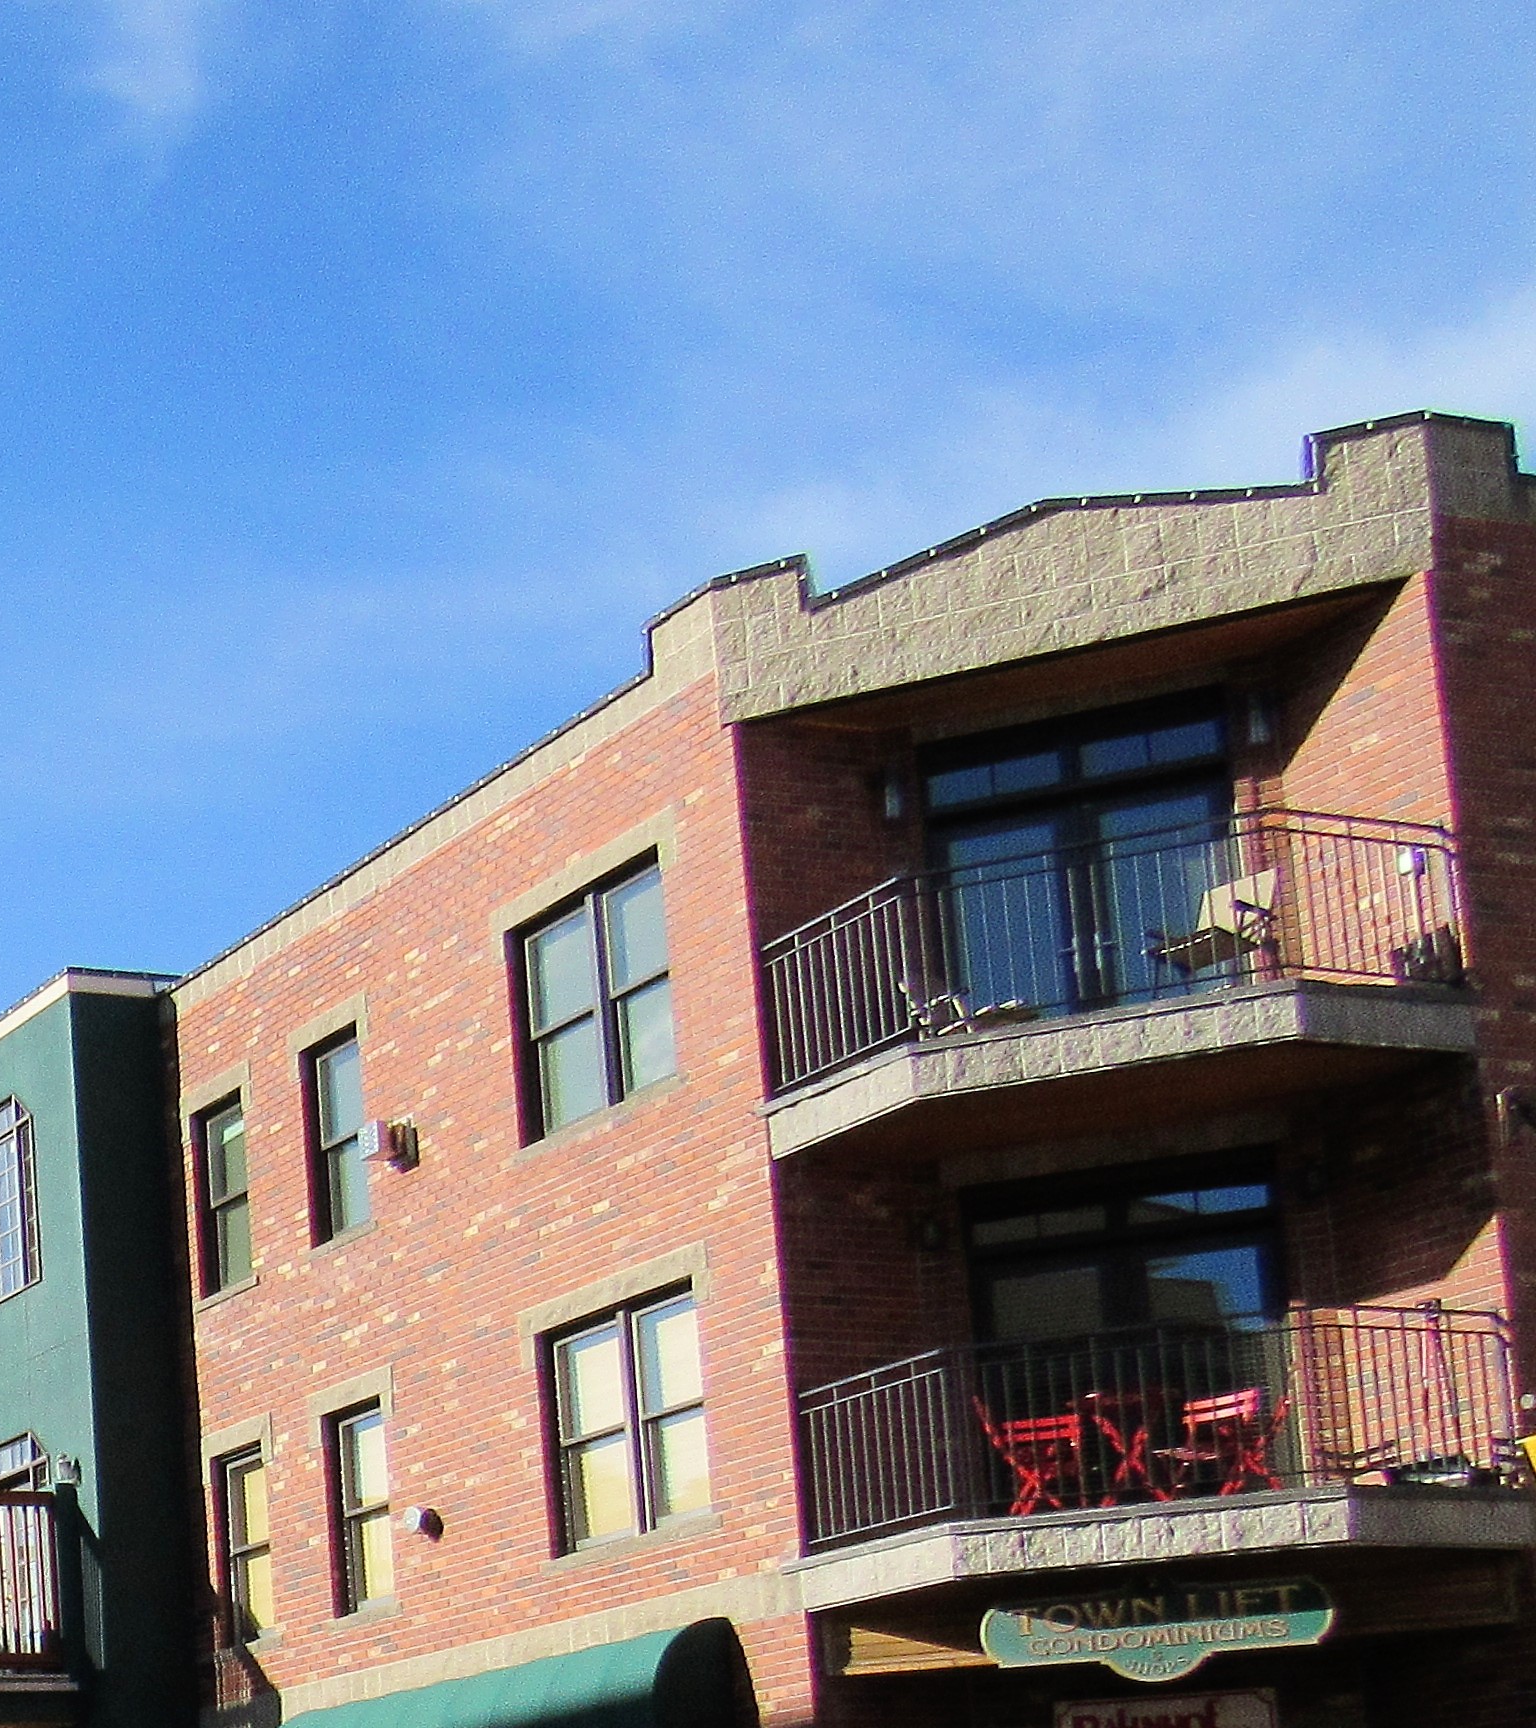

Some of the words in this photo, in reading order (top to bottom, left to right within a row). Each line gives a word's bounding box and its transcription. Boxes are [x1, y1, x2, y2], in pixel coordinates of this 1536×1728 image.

[1010, 1596, 1165, 1636] TOWN
[1187, 1584, 1301, 1622] LIFT
[1031, 1618, 1290, 1656] CONDOMINIUMS
